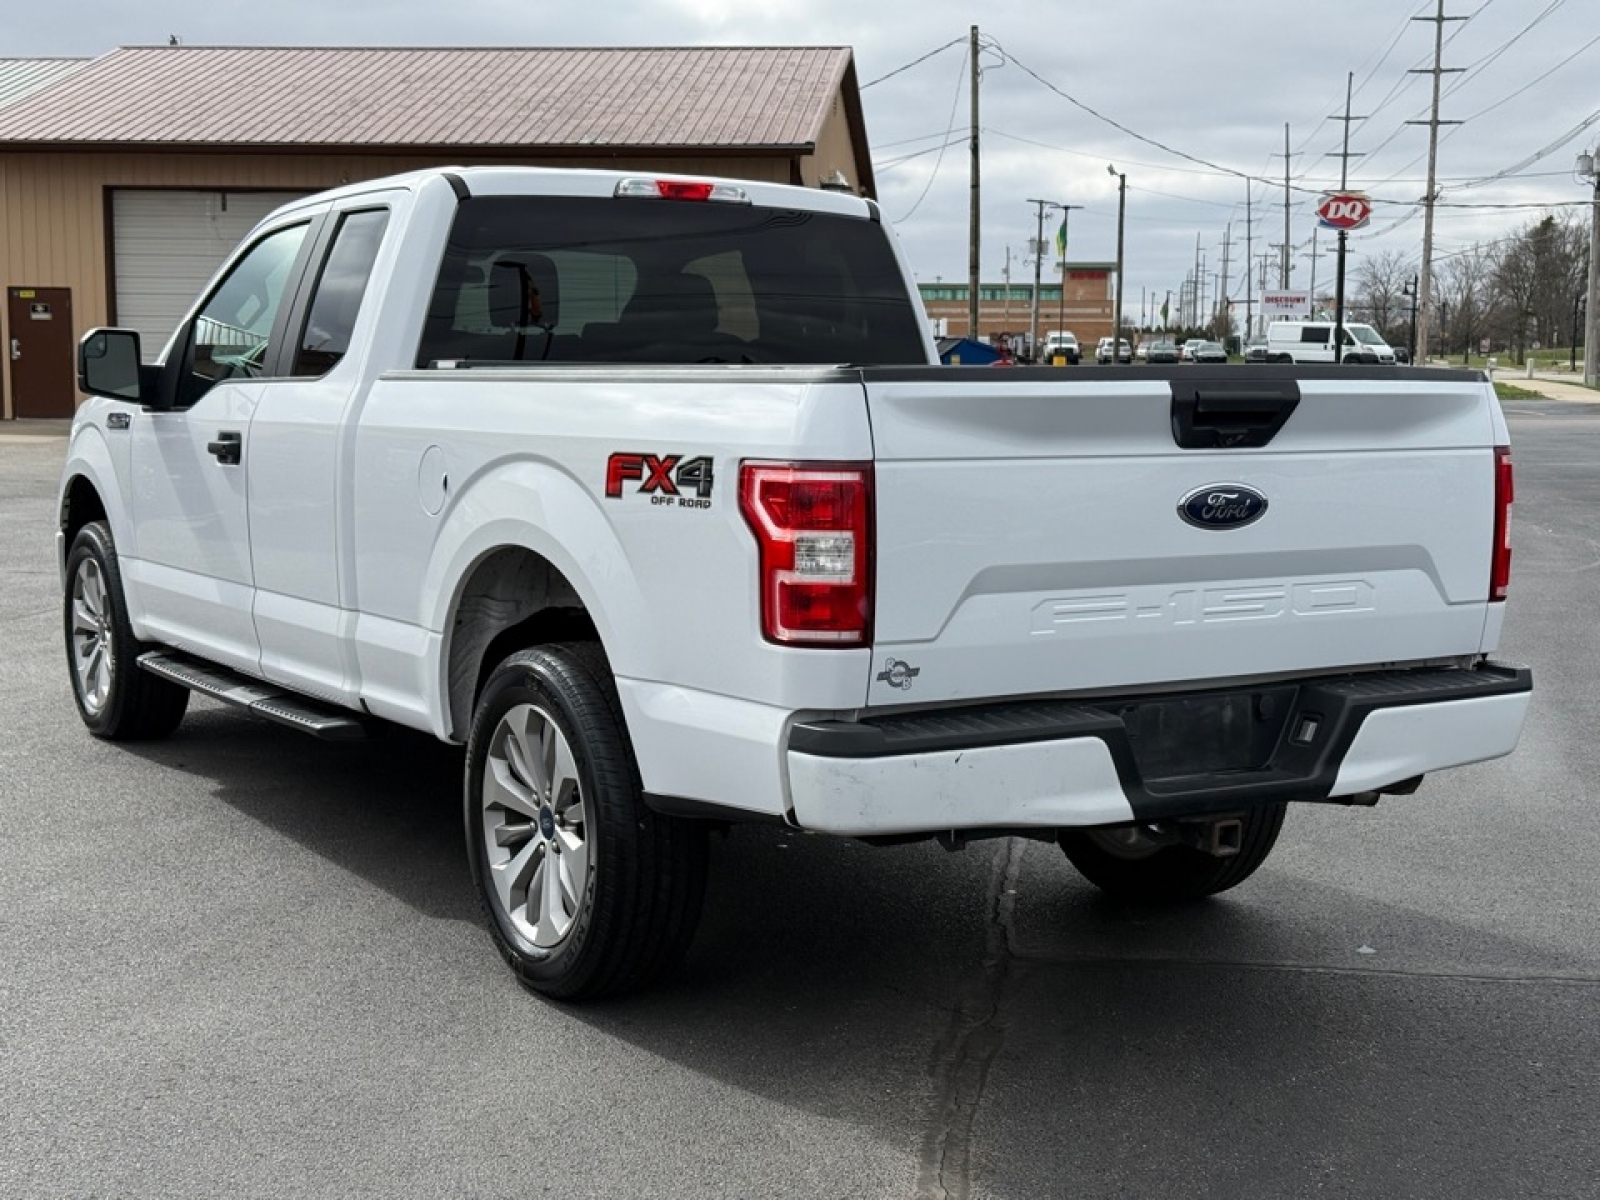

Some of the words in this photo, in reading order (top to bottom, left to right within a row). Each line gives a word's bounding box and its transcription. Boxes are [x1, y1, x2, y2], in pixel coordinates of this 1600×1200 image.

[1327, 201, 1362, 220] DQ
[1265, 296, 1305, 304] DISCOUNT
[605, 452, 714, 499] FX4
[651, 497, 674, 506] OFF
[679, 498, 711, 509] ROAD
[1201, 493, 1251, 519] Ford
[1029, 579, 1376, 636] F-150
